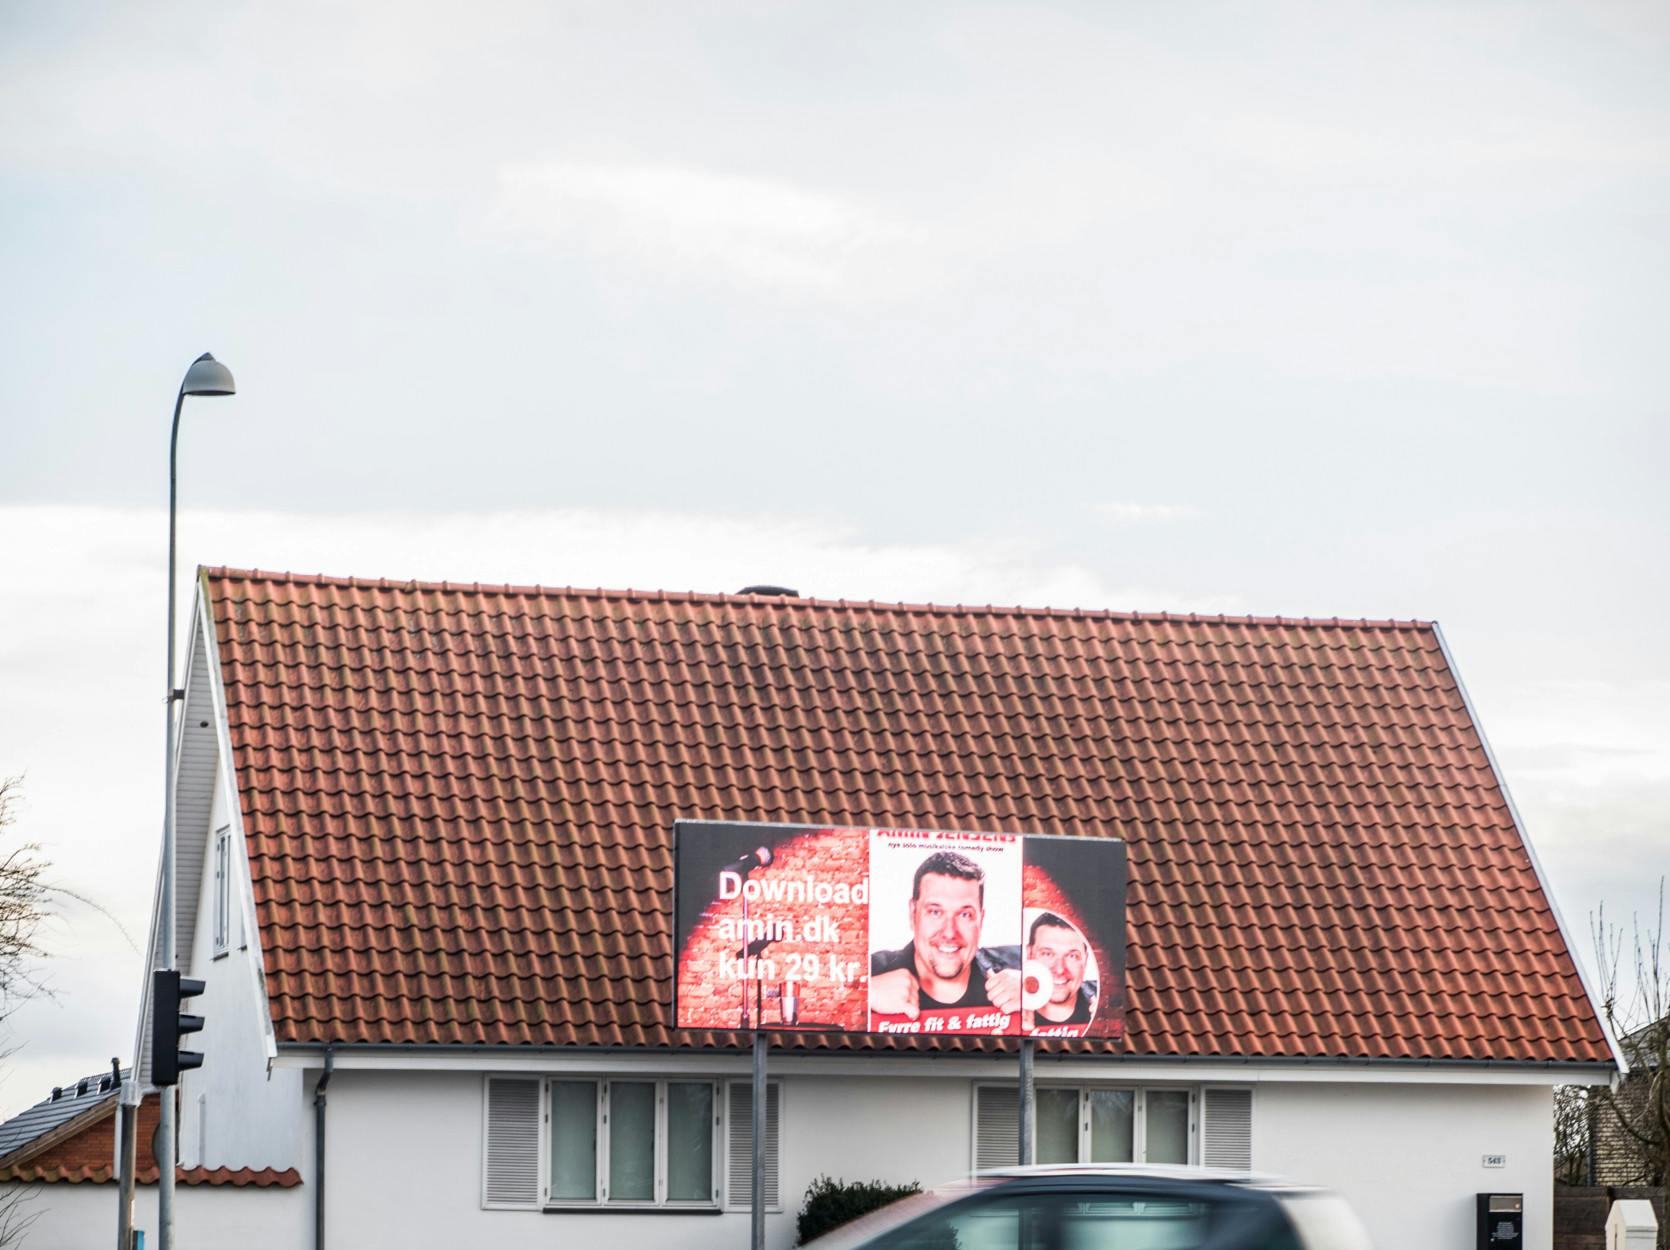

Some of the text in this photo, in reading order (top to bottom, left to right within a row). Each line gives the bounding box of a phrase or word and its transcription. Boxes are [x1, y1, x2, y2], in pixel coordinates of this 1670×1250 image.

[719, 871, 869, 905] Download
[718, 915, 839, 942] amin.dk
[719, 952, 868, 983] kun 29 kr.
[924, 1016, 944, 1032] fit
[948, 1016, 962, 1030] &
[966, 1012, 1011, 1029] fattig
